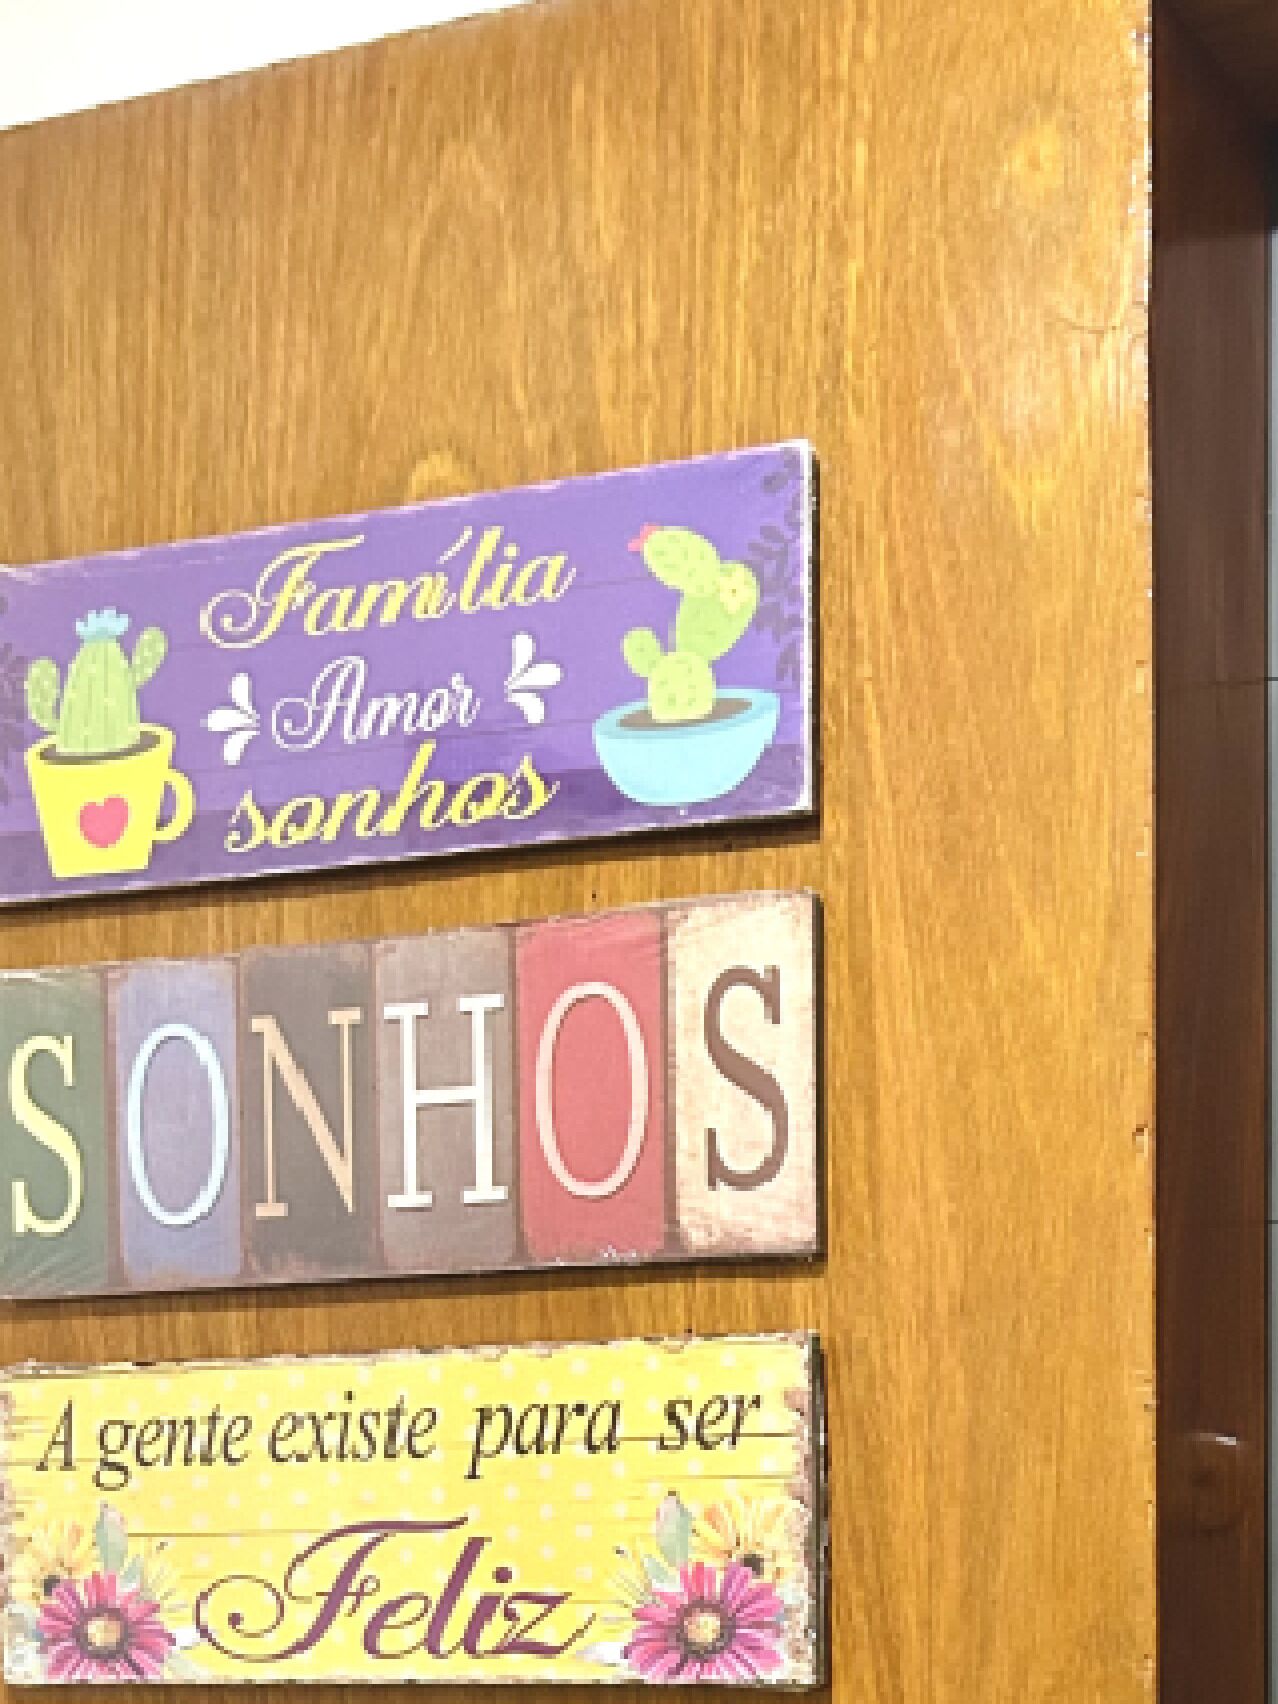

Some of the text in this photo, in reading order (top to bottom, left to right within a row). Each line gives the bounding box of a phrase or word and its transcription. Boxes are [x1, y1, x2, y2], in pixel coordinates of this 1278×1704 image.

[199, 524, 577, 650] Família
[271, 655, 482, 751] Amor
[223, 740, 561, 854] sonhos
[8, 963, 790, 1238] SONHOS
[35, 1388, 762, 1492] A gente existe para ser
[195, 1515, 597, 1665] Feliz
